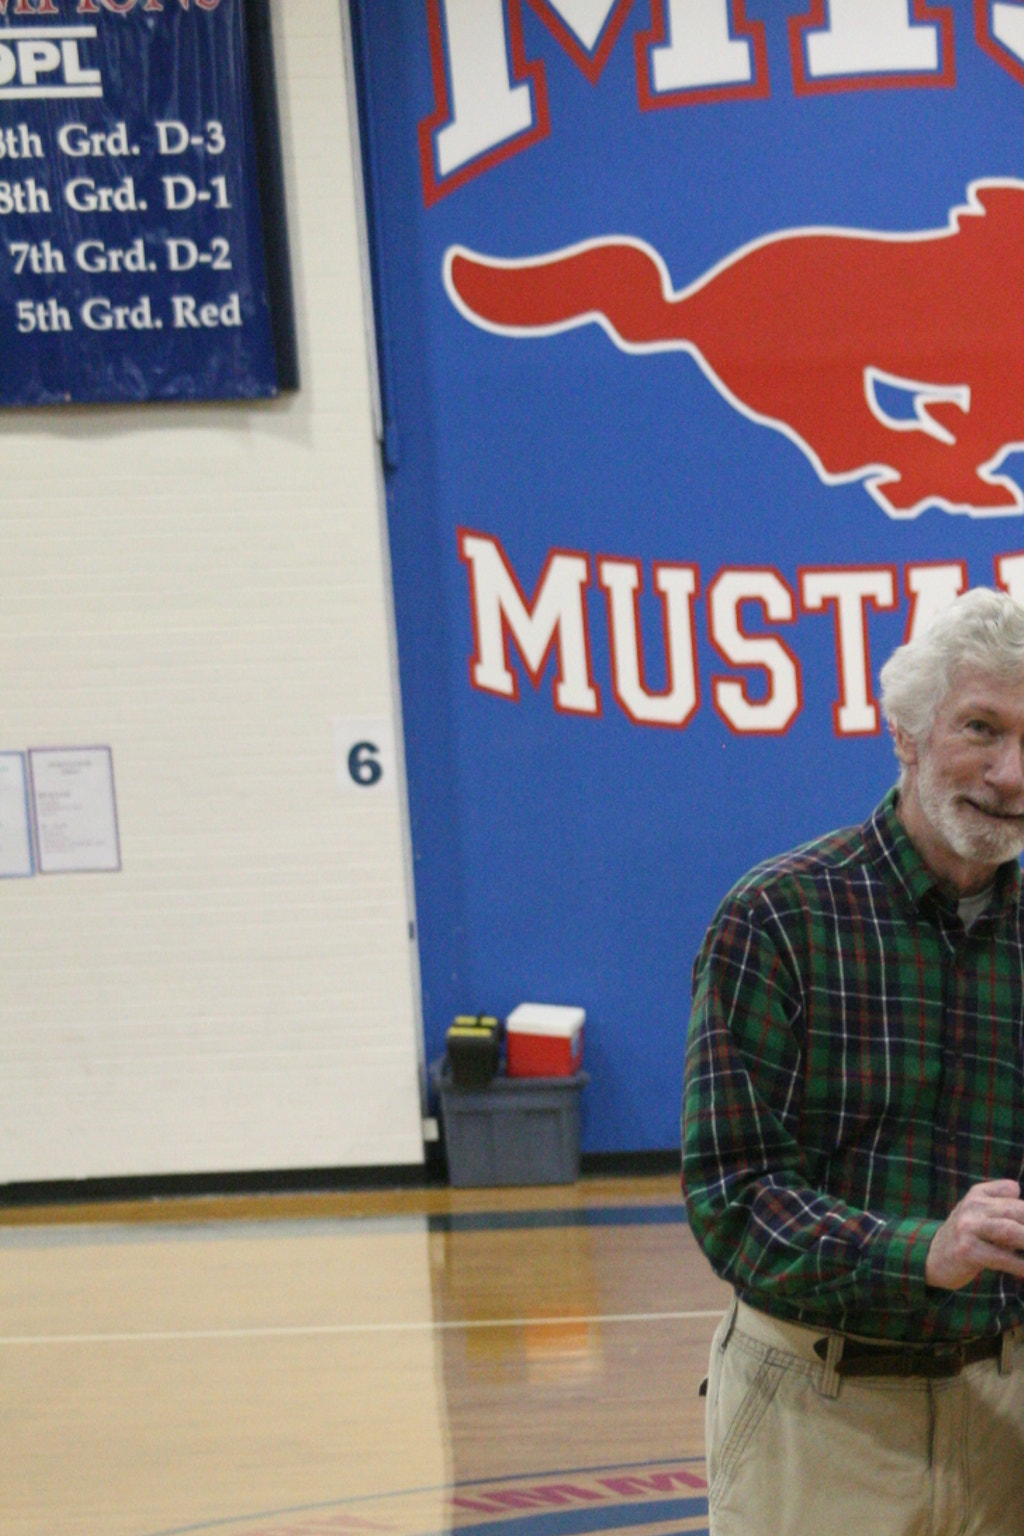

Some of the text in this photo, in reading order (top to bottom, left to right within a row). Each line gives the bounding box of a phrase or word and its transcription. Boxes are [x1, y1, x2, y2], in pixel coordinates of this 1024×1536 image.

[57, 121, 141, 157] Grd.
[155, 119, 226, 155] D-3
[0, 174, 232, 214] 8th Grd. D-1
[9, 237, 233, 274] 7th Grd. D-2
[16, 293, 243, 333] 5th Grd. Red
[347, 740, 384, 788] 6
